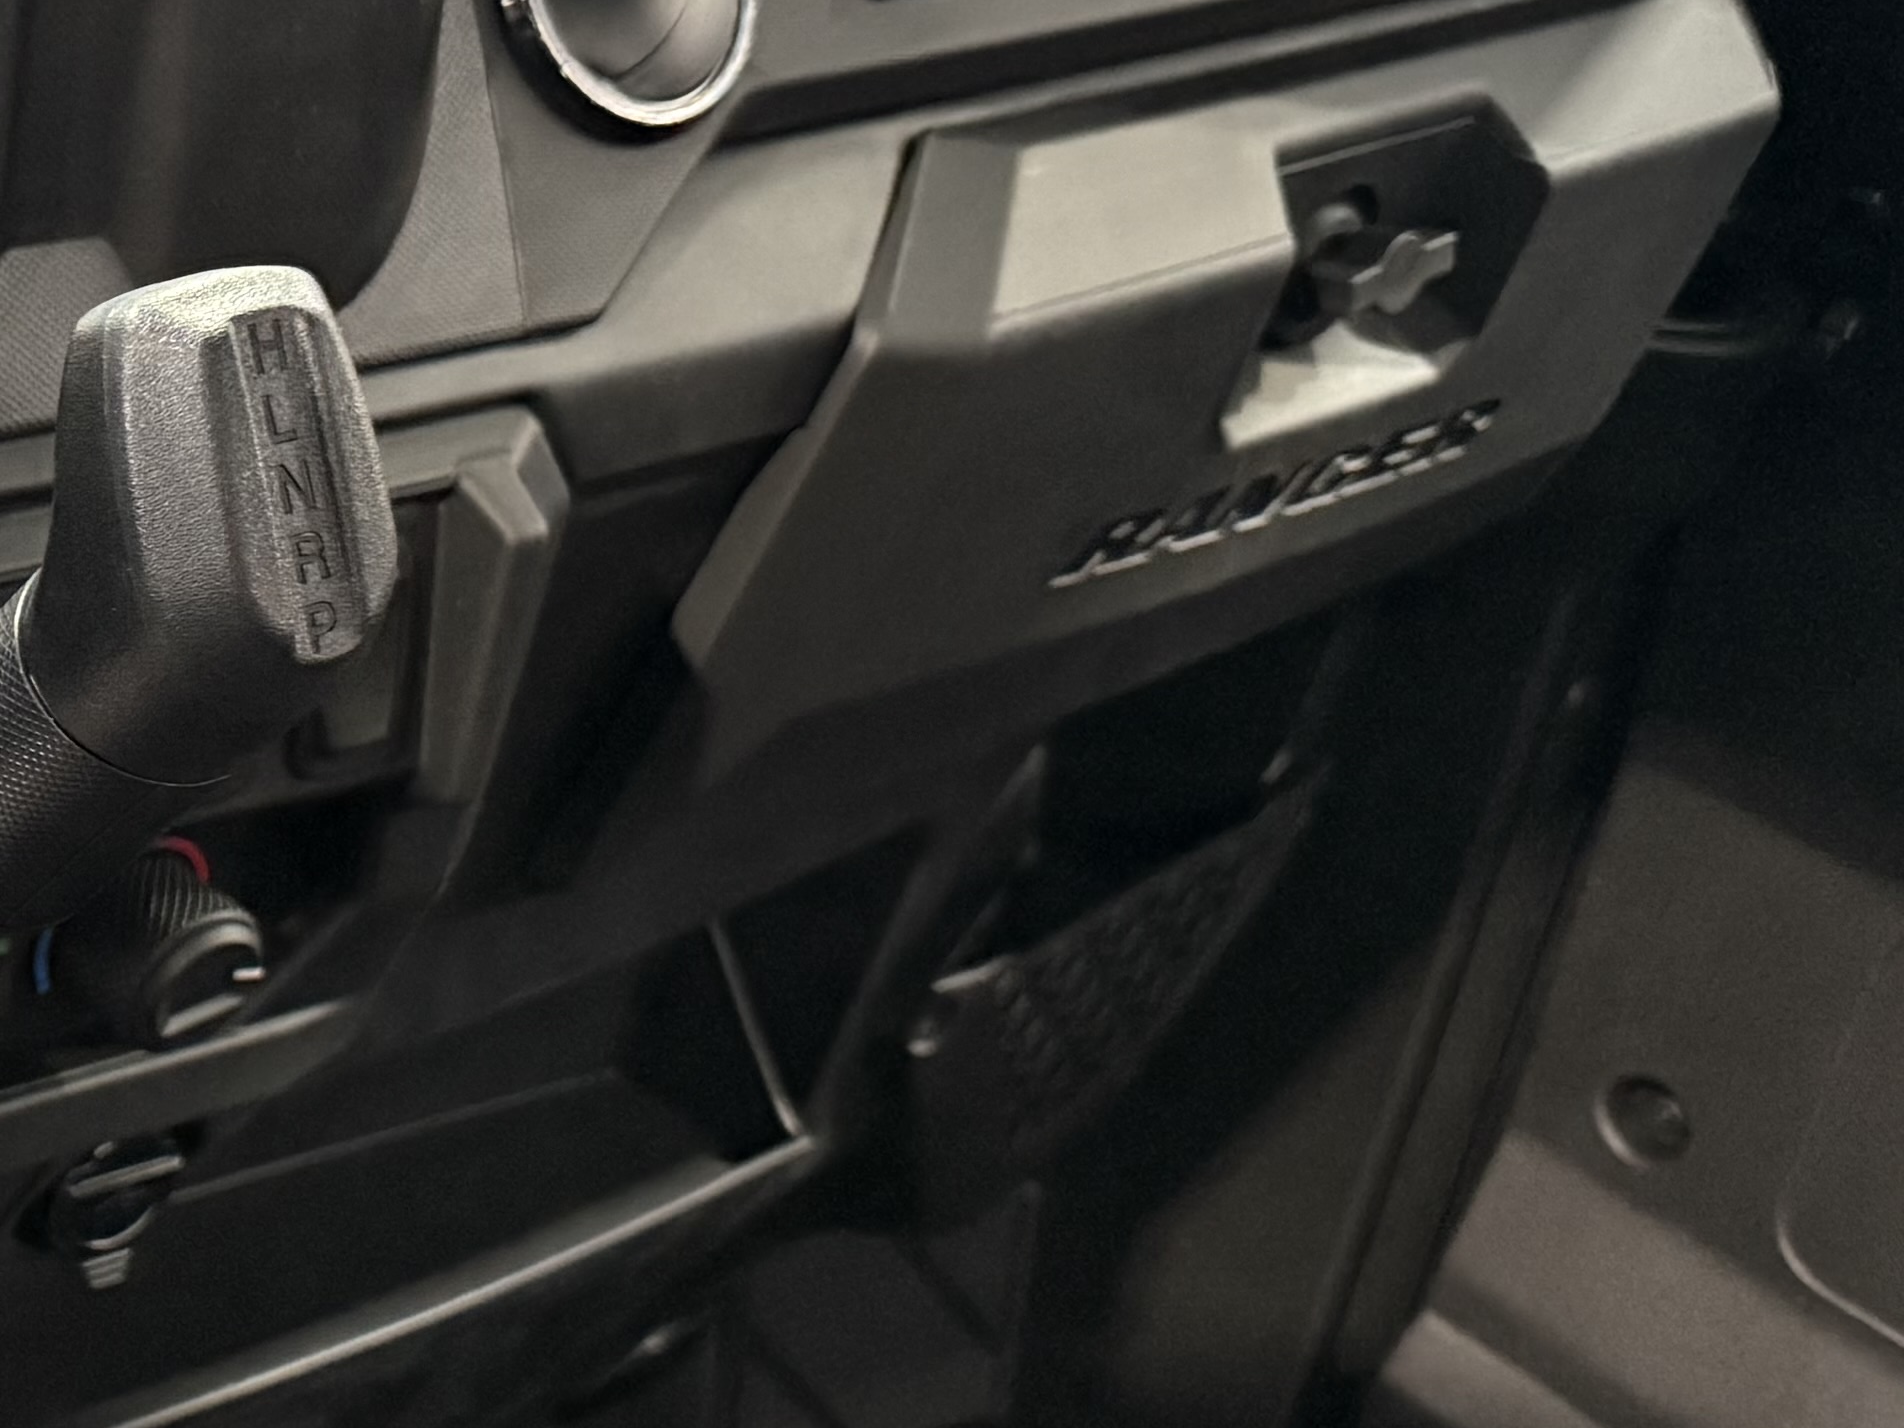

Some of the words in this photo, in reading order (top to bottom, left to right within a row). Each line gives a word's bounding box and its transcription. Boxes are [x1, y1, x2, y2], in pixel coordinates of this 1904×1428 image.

[248, 317, 290, 376] H
[261, 394, 298, 445] L
[275, 459, 318, 515] N
[293, 530, 331, 585] R
[303, 600, 338, 654] P
